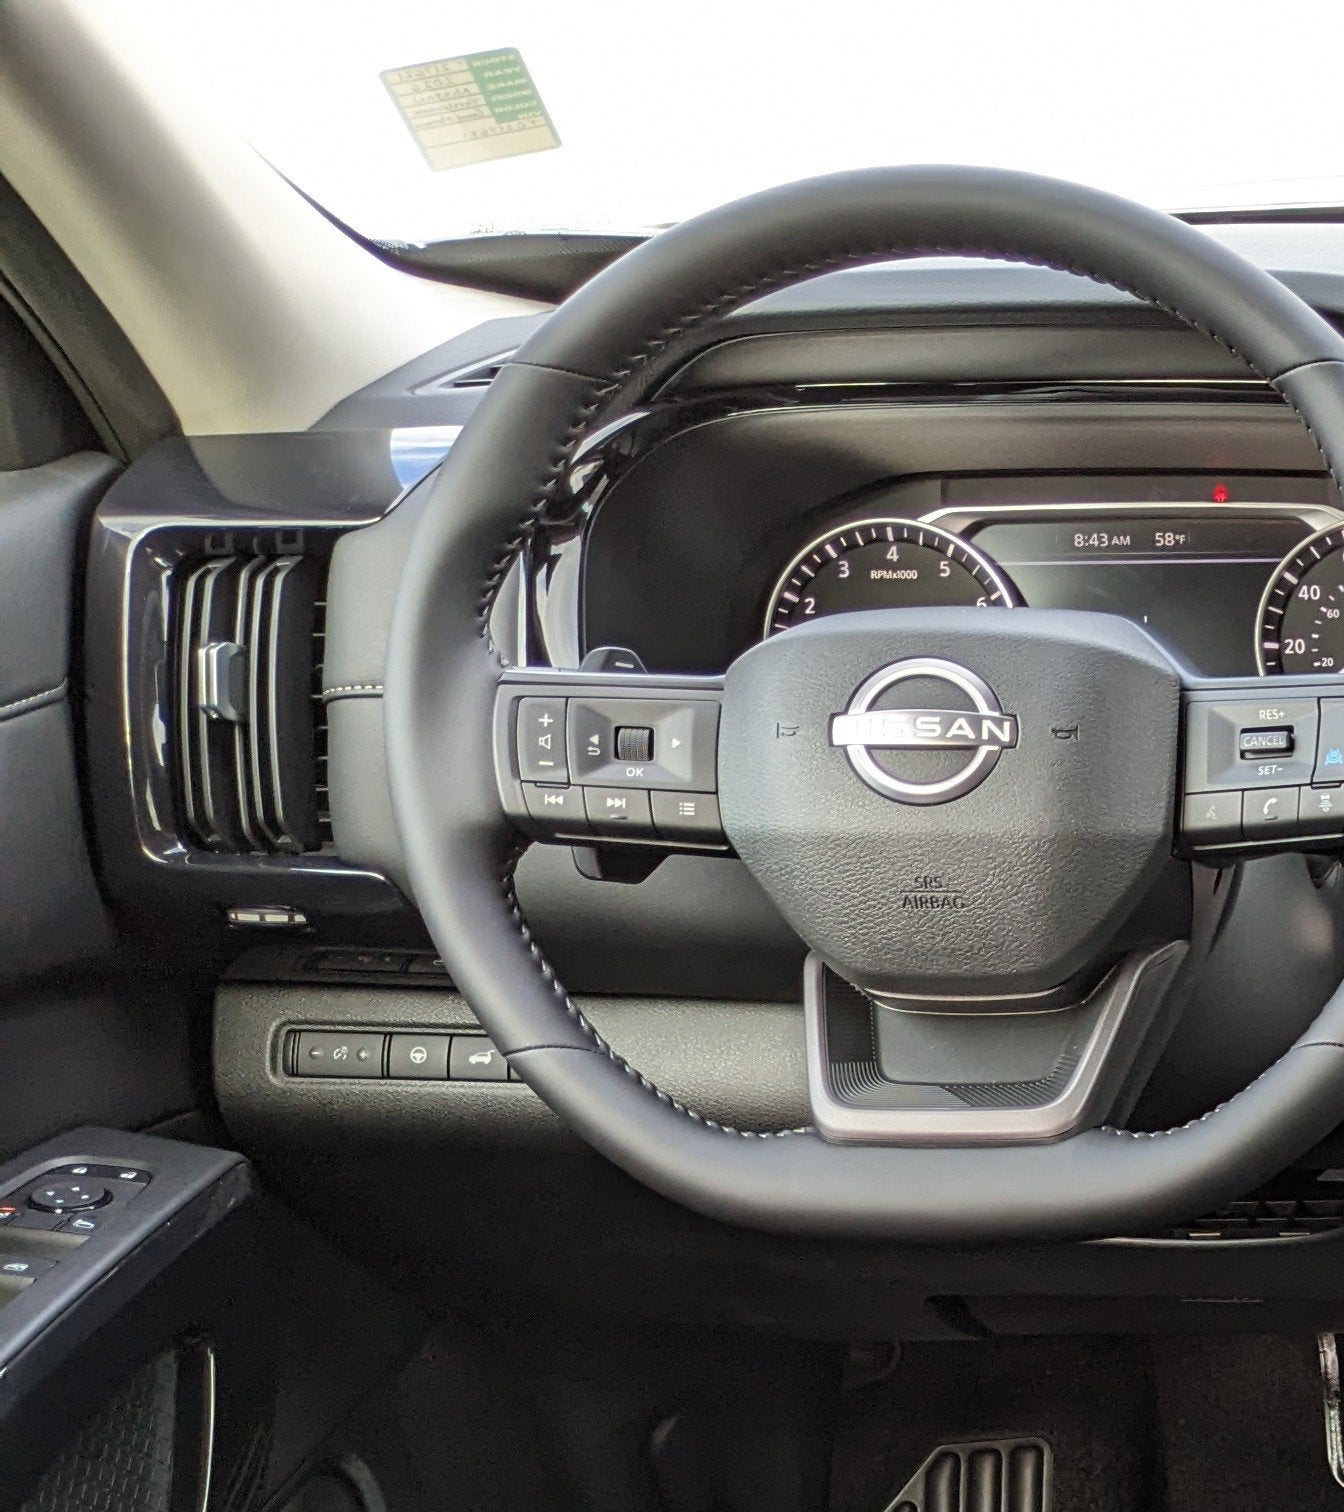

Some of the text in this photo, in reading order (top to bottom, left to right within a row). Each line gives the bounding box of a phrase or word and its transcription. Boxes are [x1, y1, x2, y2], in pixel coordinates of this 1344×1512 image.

[1074, 533, 1131, 547] 8:43 AM
[887, 546, 899, 562] 4
[839, 561, 850, 578] 3
[940, 563, 950, 576] 5
[1299, 585, 1320, 600] 40
[805, 599, 815, 614] 2
[1327, 609, 1339, 618] 60
[1285, 639, 1305, 653] 20
[1321, 657, 1333, 667] 20
[1259, 710, 1285, 720] RES+
[1244, 735, 1284, 746] CANCEL
[626, 768, 644, 777] OK
[914, 876, 943, 888] SRS
[902, 895, 964, 910] AIRBAG
